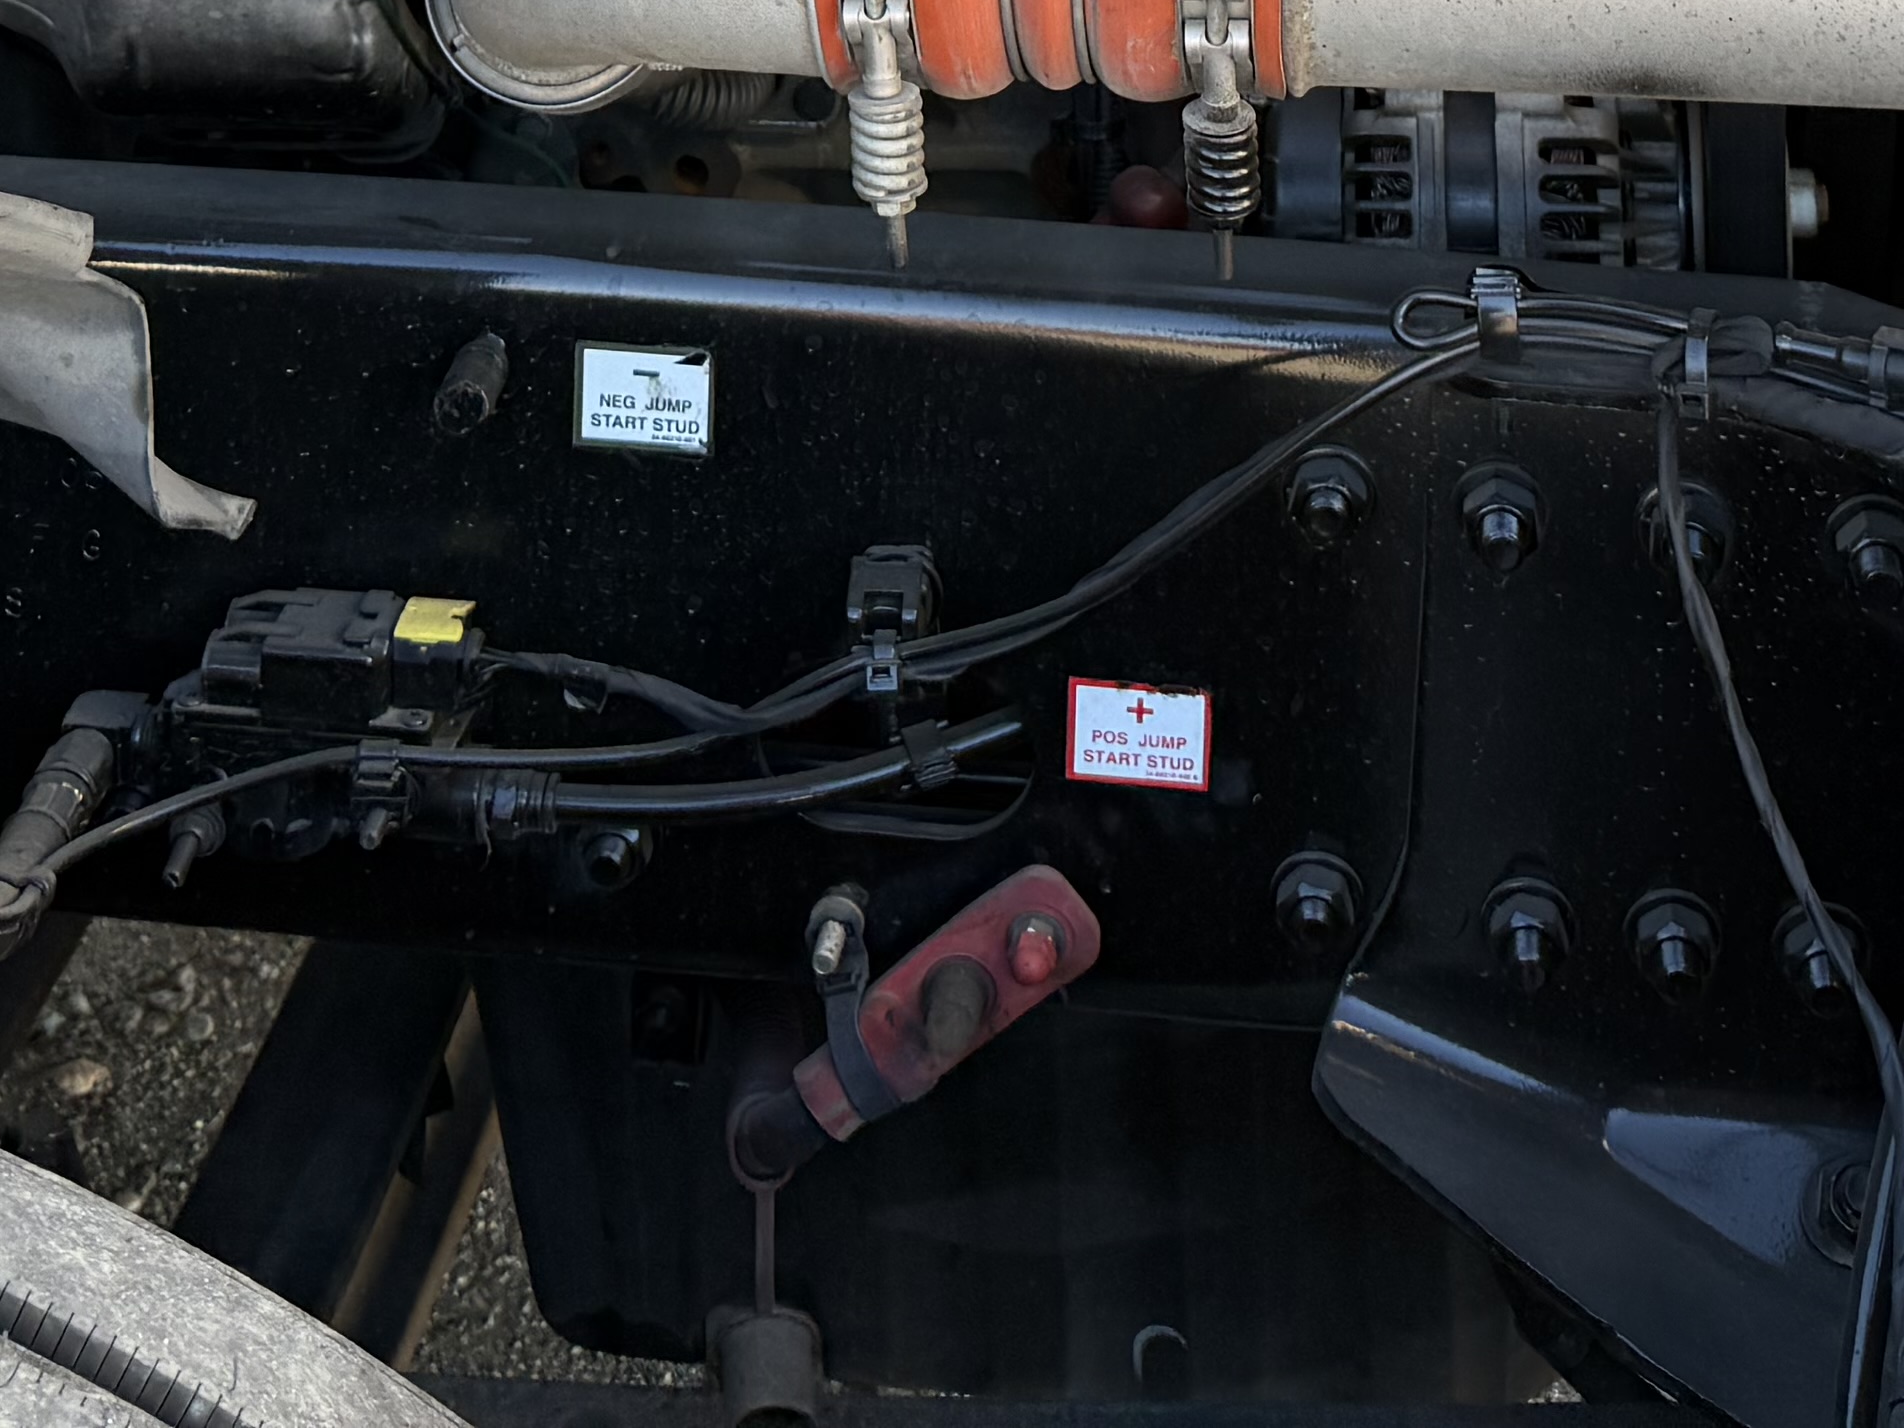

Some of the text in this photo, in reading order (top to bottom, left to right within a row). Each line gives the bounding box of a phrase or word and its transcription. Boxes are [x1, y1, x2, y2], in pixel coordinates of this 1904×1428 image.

[599, 393, 692, 413] NEG JUMP
[590, 412, 700, 434] START STUD
[1091, 729, 1188, 751] POS JUMP
[1083, 749, 1195, 771] START STUD
